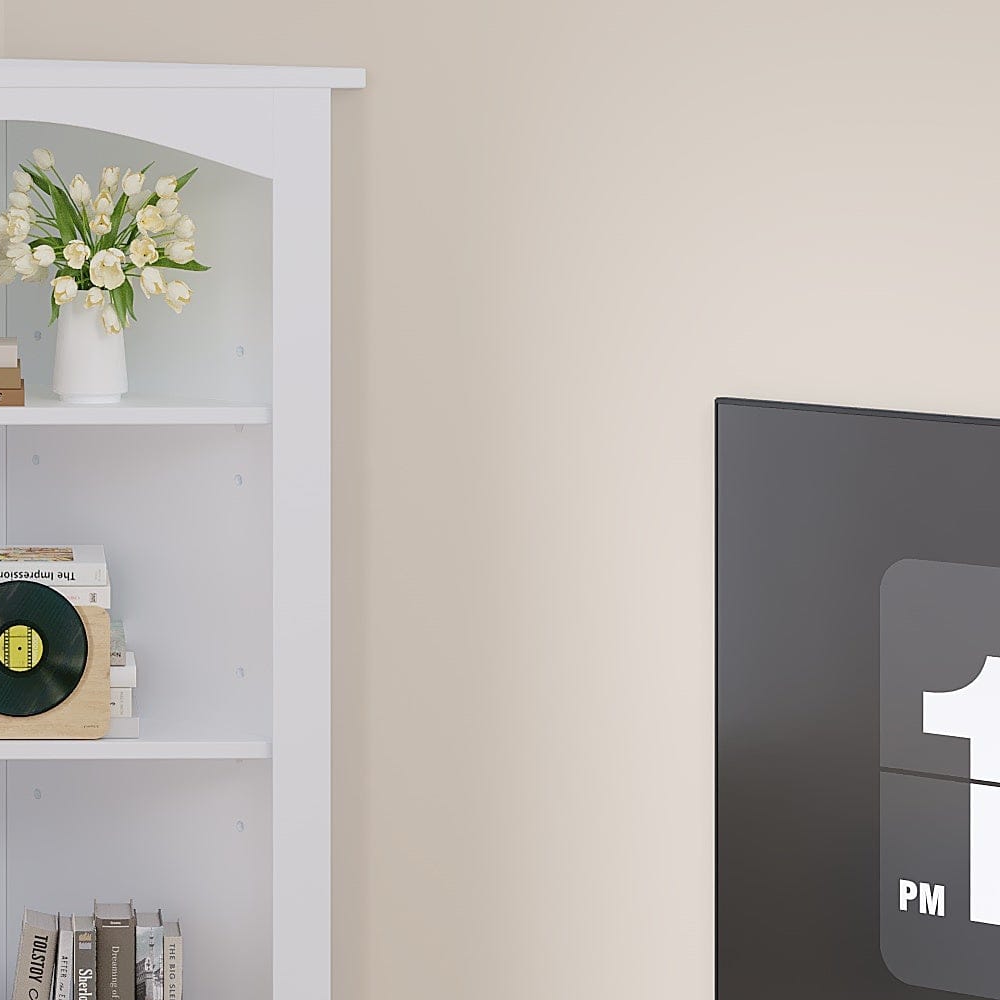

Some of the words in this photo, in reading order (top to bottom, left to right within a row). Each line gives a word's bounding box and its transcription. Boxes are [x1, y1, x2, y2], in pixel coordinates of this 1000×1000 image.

[57, 571, 76, 581] The
[899, 878, 946, 918] PM
[28, 935, 49, 983] TOLSTOY
[60, 955, 68, 978] AFTER
[110, 946, 120, 988] Dreaming
[111, 989, 120, 998] of
